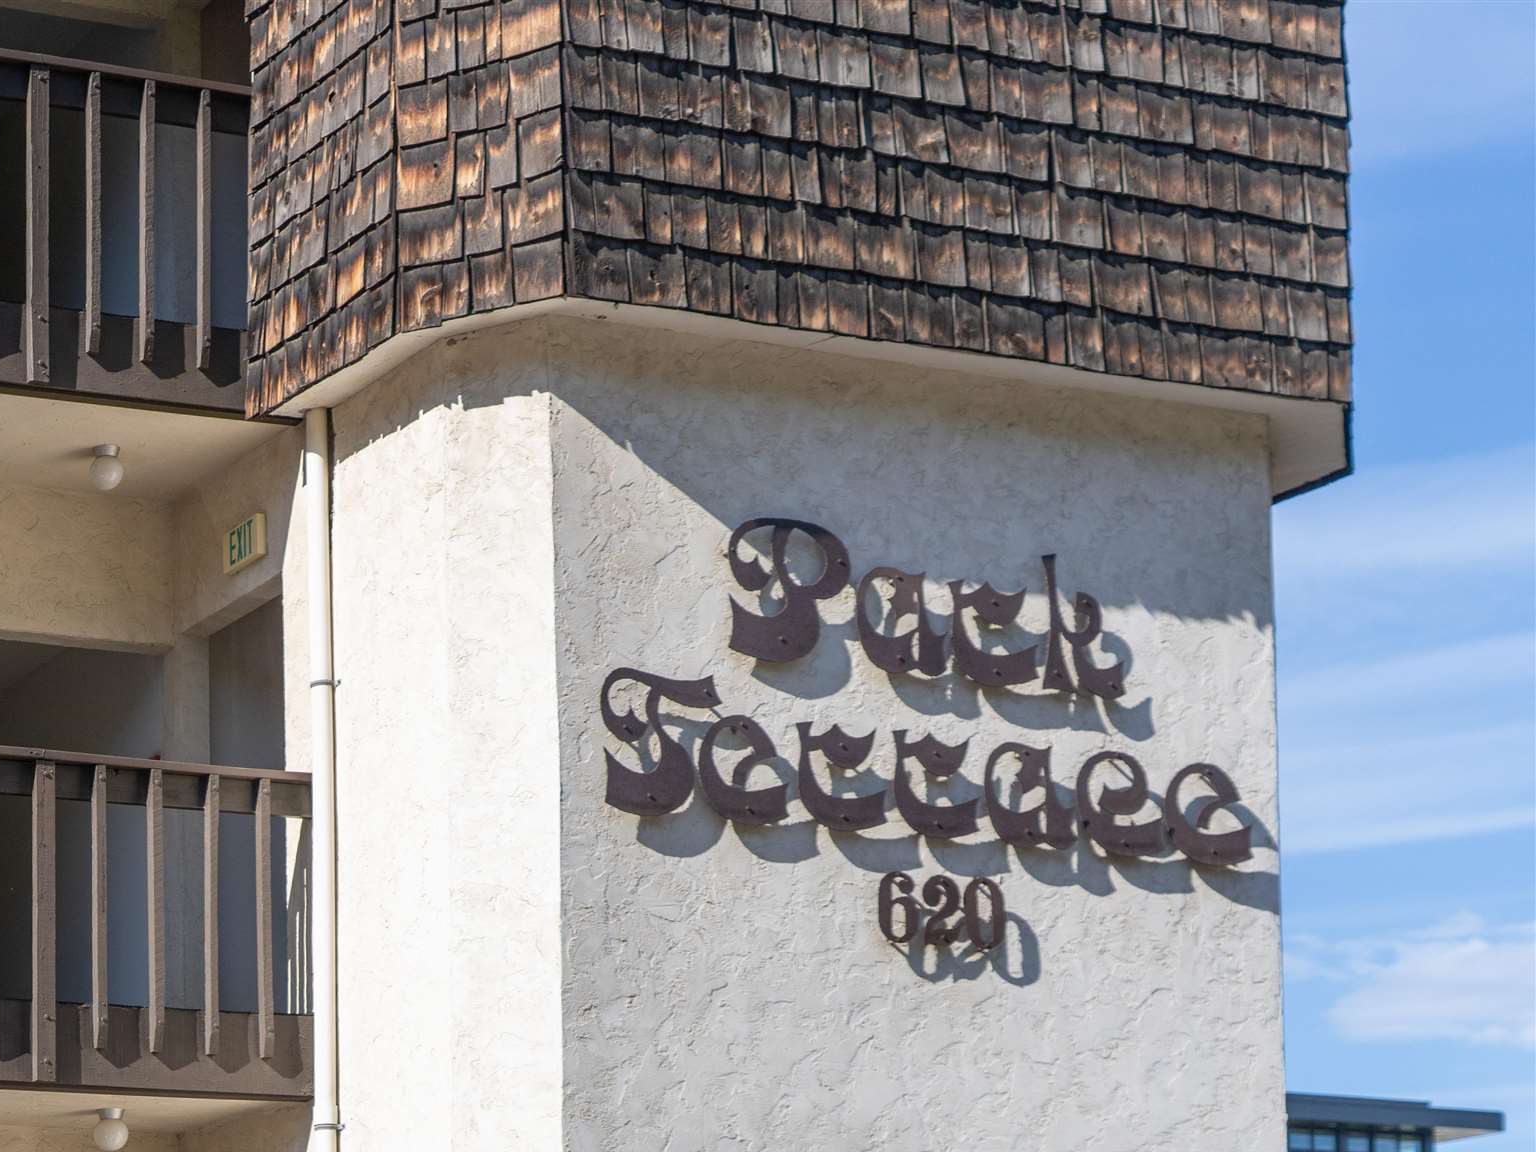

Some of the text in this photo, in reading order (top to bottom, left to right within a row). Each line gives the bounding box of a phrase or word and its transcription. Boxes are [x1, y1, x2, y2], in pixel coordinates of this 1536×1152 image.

[229, 518, 254, 566] EXIT
[727, 517, 1126, 700] Park
[600, 667, 1253, 866] Terrace
[877, 870, 1005, 951] 620
